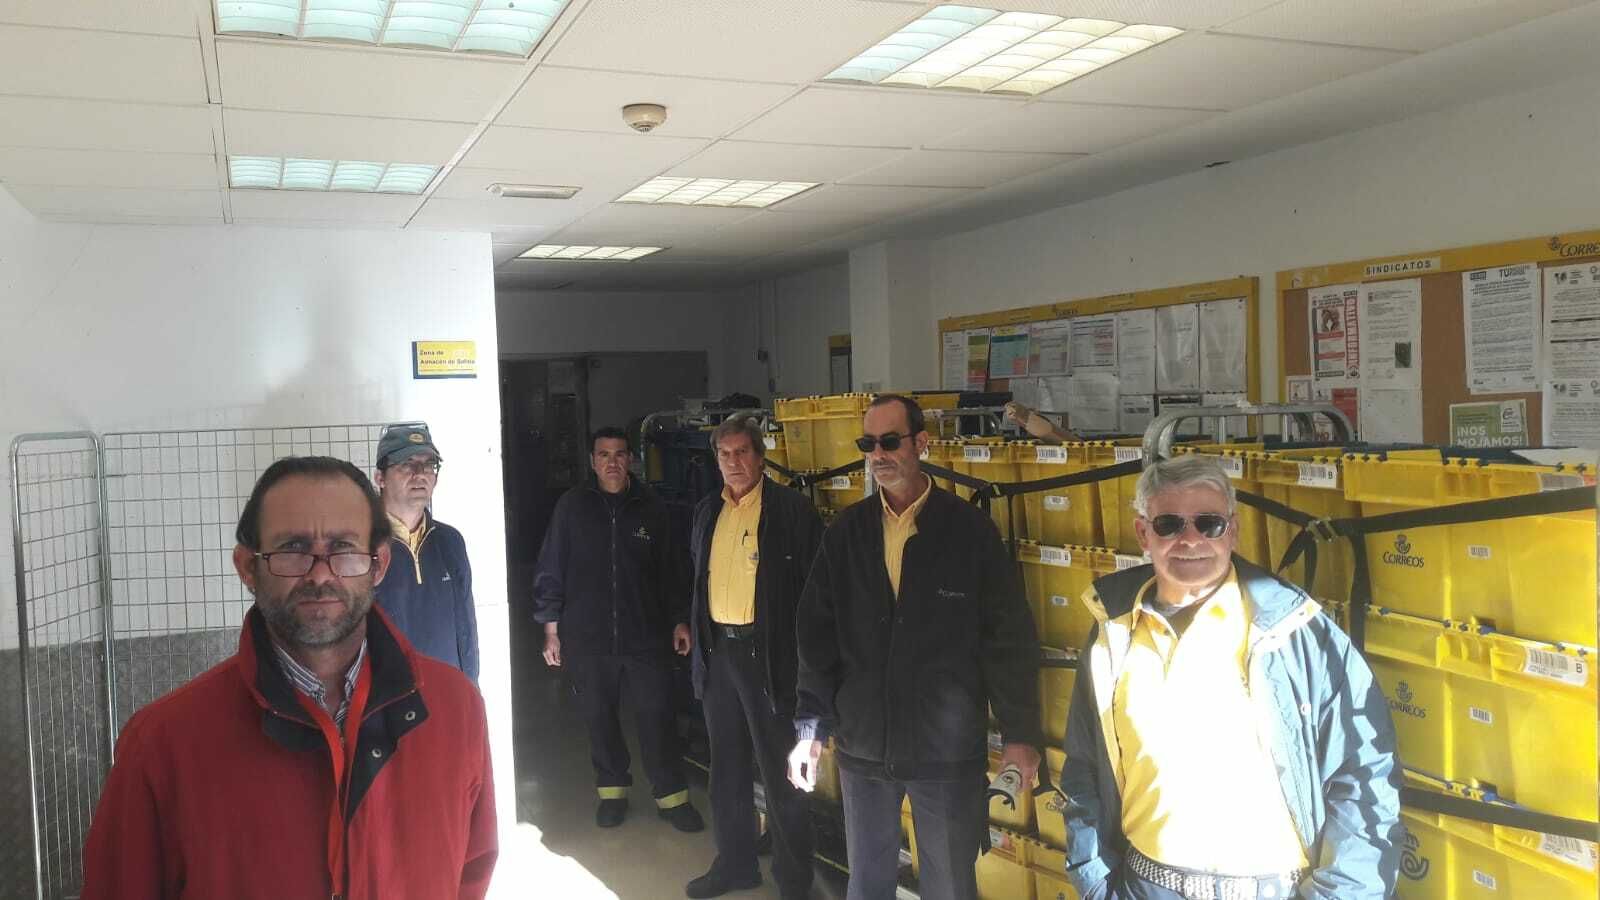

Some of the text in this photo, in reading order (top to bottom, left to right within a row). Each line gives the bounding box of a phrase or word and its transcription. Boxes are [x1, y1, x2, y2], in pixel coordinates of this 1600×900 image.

[1366, 260, 1432, 275] SINDICATOS
[1383, 551, 1425, 568] CORREOS
[1575, 662, 1583, 673] B
[1386, 698, 1427, 718] ORREOS
